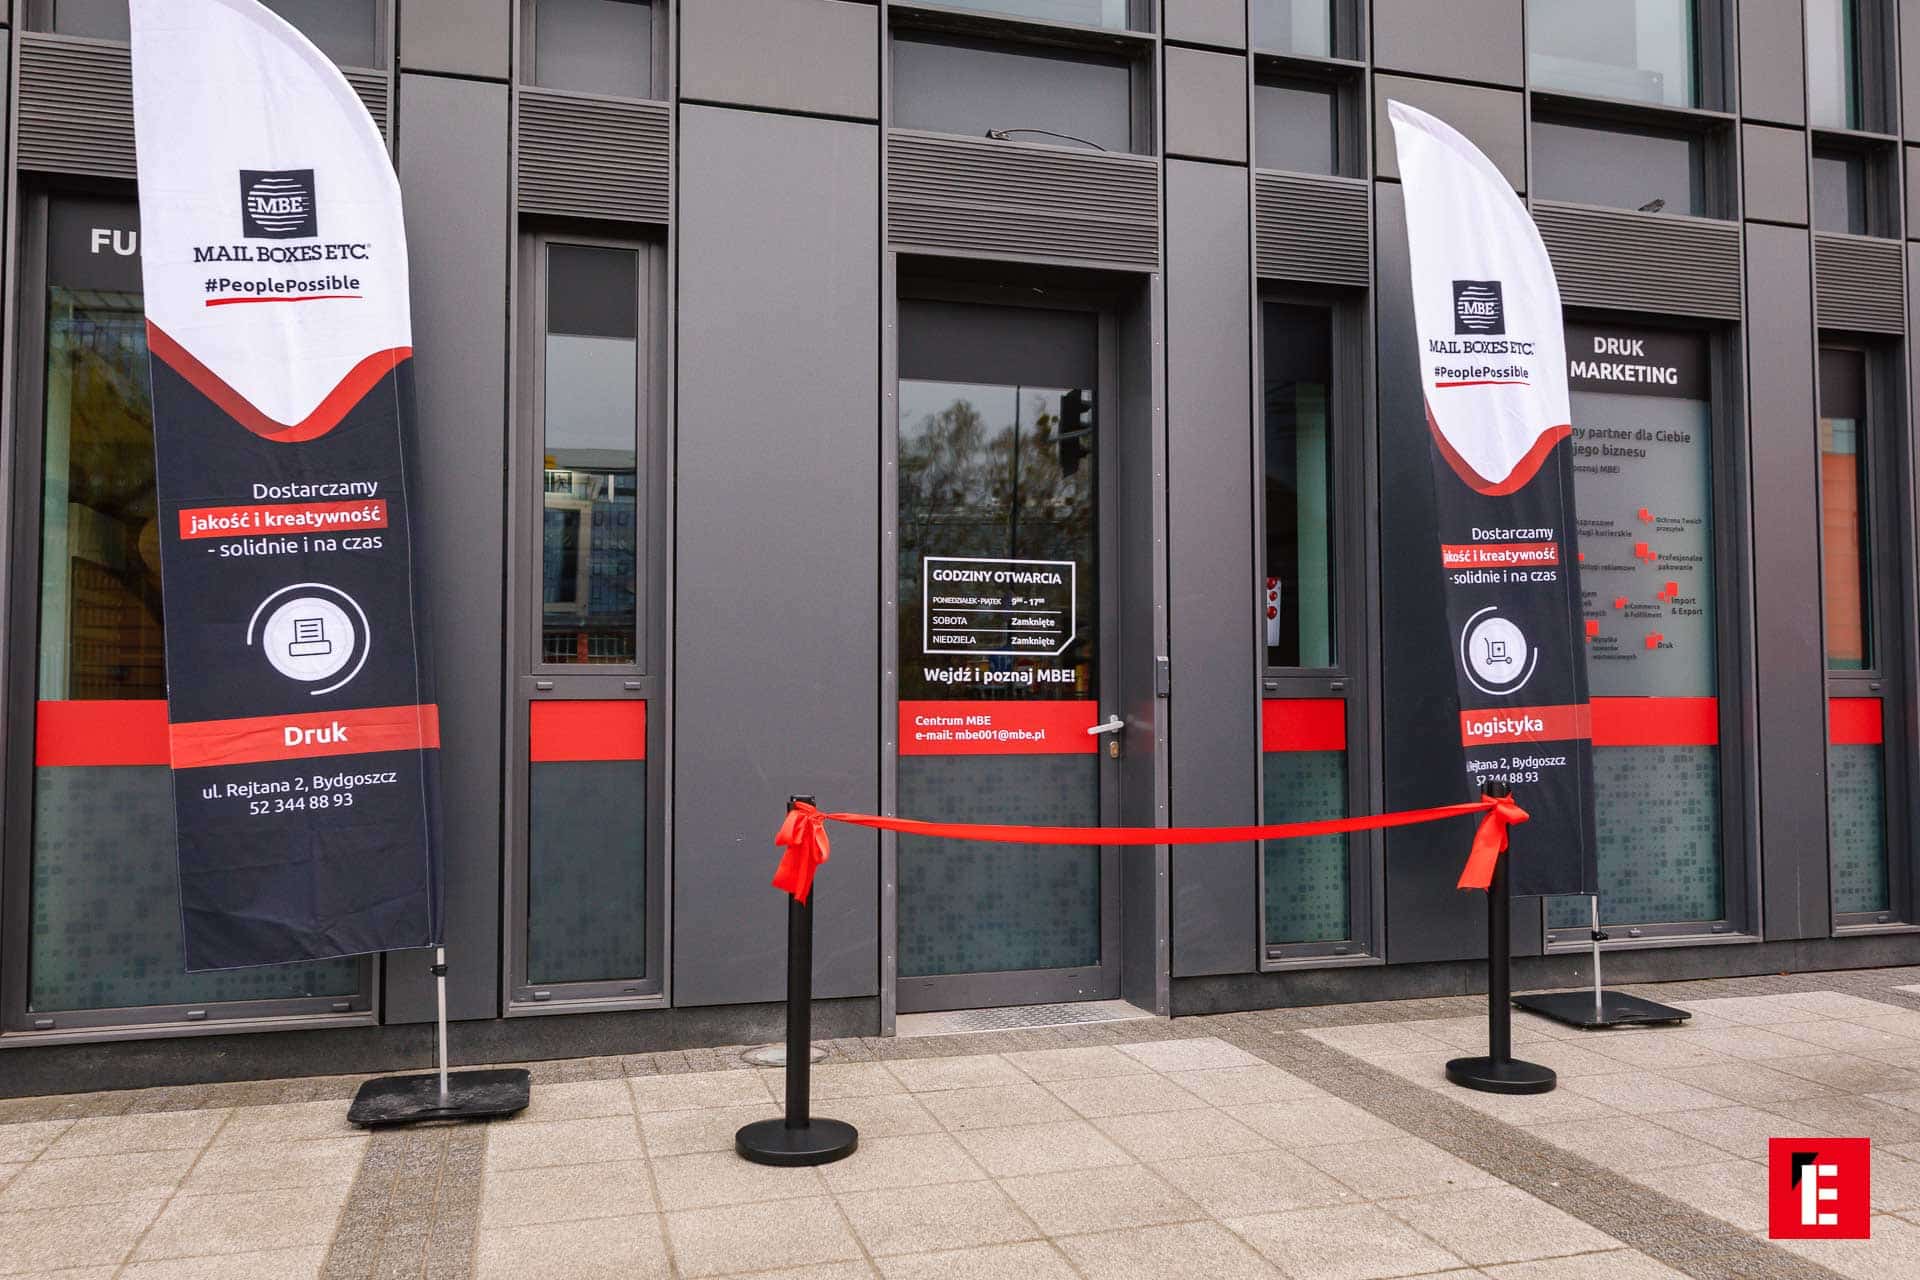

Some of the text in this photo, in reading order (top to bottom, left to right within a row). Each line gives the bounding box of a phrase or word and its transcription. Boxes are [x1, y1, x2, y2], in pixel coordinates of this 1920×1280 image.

[255, 197, 303, 214] MBE
[193, 247, 253, 263] MAIL
[257, 245, 322, 263] BOXES
[205, 275, 360, 295] #PeoplePossible
[1463, 301, 1495, 316] MBE
[1429, 339, 1460, 354] MAIL
[1463, 341, 1508, 354] BOXES
[1593, 336, 1645, 357] DRUK
[1434, 365, 1529, 380] #PeoplePossible
[1570, 360, 1678, 385] MARKETING
[1588, 429, 1632, 441] partner
[1635, 429, 1653, 441] dla
[1655, 430, 1691, 443] Ciebie
[1602, 443, 1646, 457] biznesu
[253, 481, 378, 499] Dostarczamy
[190, 506, 381, 534] jakość i kreatywność
[1471, 527, 1554, 541] Dostarczamy
[220, 537, 298, 557] solidnie
[304, 536, 309, 552] i
[314, 538, 337, 551] na
[342, 536, 383, 550] czas
[1480, 547, 1555, 563] kreatywność
[933, 569, 1062, 584] GODZINY OTWARCIA
[1503, 570, 1508, 583] i
[1511, 573, 1528, 582] na
[1530, 571, 1557, 581] czas
[1671, 596, 1697, 606] Import
[1678, 607, 1703, 616] Export
[932, 616, 1055, 628] SOBOTA Zamknięte
[932, 635, 1055, 647] NIEDZIELA Zamknięte
[1657, 640, 1674, 649] Druk
[923, 667, 1075, 685] Wejdź i poznaj MBE!
[915, 715, 991, 726] Centrum MBE
[1466, 715, 1544, 737] Logistyka
[283, 721, 348, 747] Druk
[915, 729, 1045, 742] e-mail: mbe001@mbe.pl
[1500, 758, 1510, 769] 2,
[1512, 755, 1566, 769] Bydgoszcz
[1509, 772, 1524, 783] 88
[1525, 771, 1539, 783] 93
[202, 771, 397, 799] ul. Rejtana 2, Bydgoszcz
[249, 793, 353, 815] 52 344 88 93
